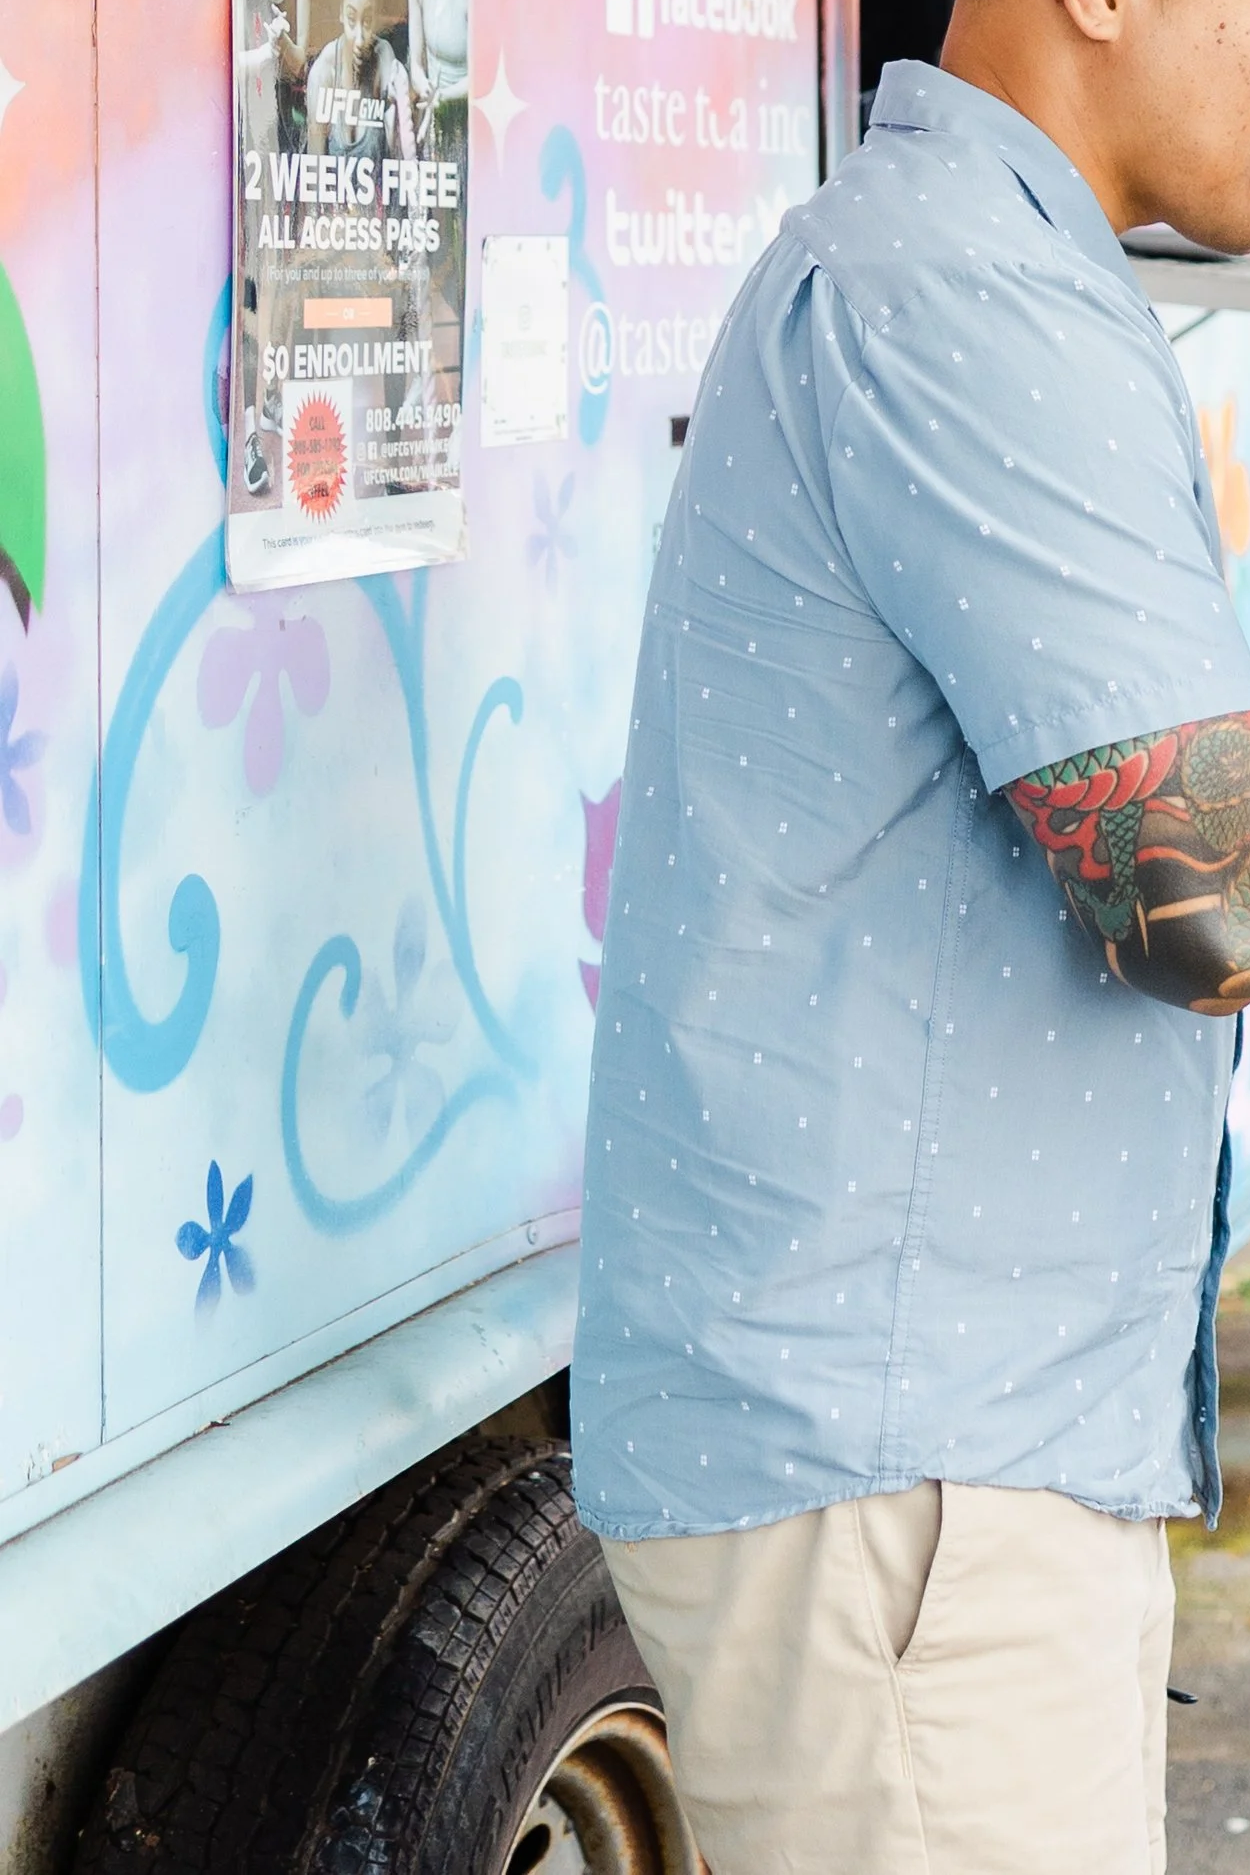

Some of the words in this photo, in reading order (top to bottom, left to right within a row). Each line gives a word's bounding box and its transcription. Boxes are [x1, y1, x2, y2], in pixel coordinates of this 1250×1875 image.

[316, 87, 361, 125] UFC
[359, 99, 386, 121] GYM
[594, 72, 687, 147] taste
[758, 77, 811, 156] inc
[245, 150, 262, 200] 2
[269, 153, 375, 205] WEEKS
[382, 159, 458, 208] FREE
[258, 214, 296, 250] ALL
[300, 215, 383, 251] ACCESS
[386, 218, 440, 253] PASS
[606, 188, 753, 267] twitter
[263, 341, 290, 384] $0
[294, 340, 432, 378] ENROLLMENT
